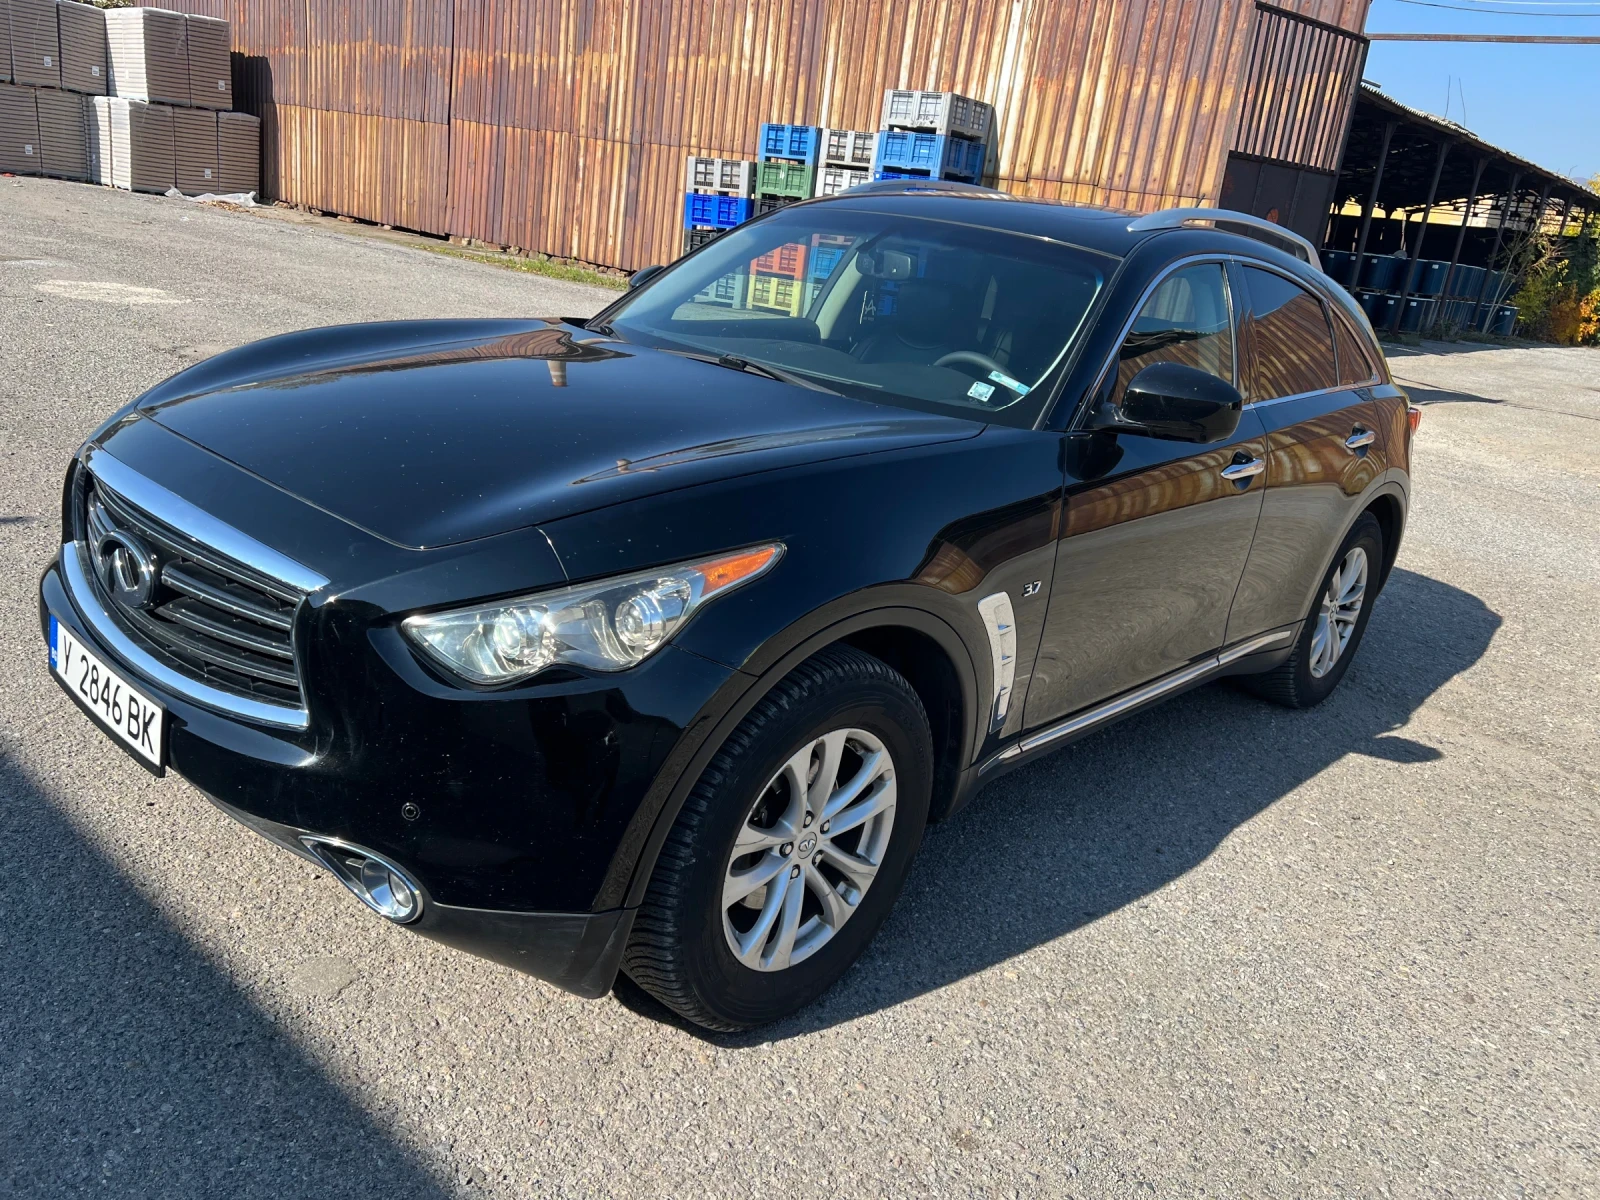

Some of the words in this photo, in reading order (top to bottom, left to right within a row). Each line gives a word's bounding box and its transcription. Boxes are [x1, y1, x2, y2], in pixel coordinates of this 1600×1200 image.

[1021, 580, 1042, 598] 3.7
[79, 654, 123, 726] 2846
[127, 693, 156, 755] BK
